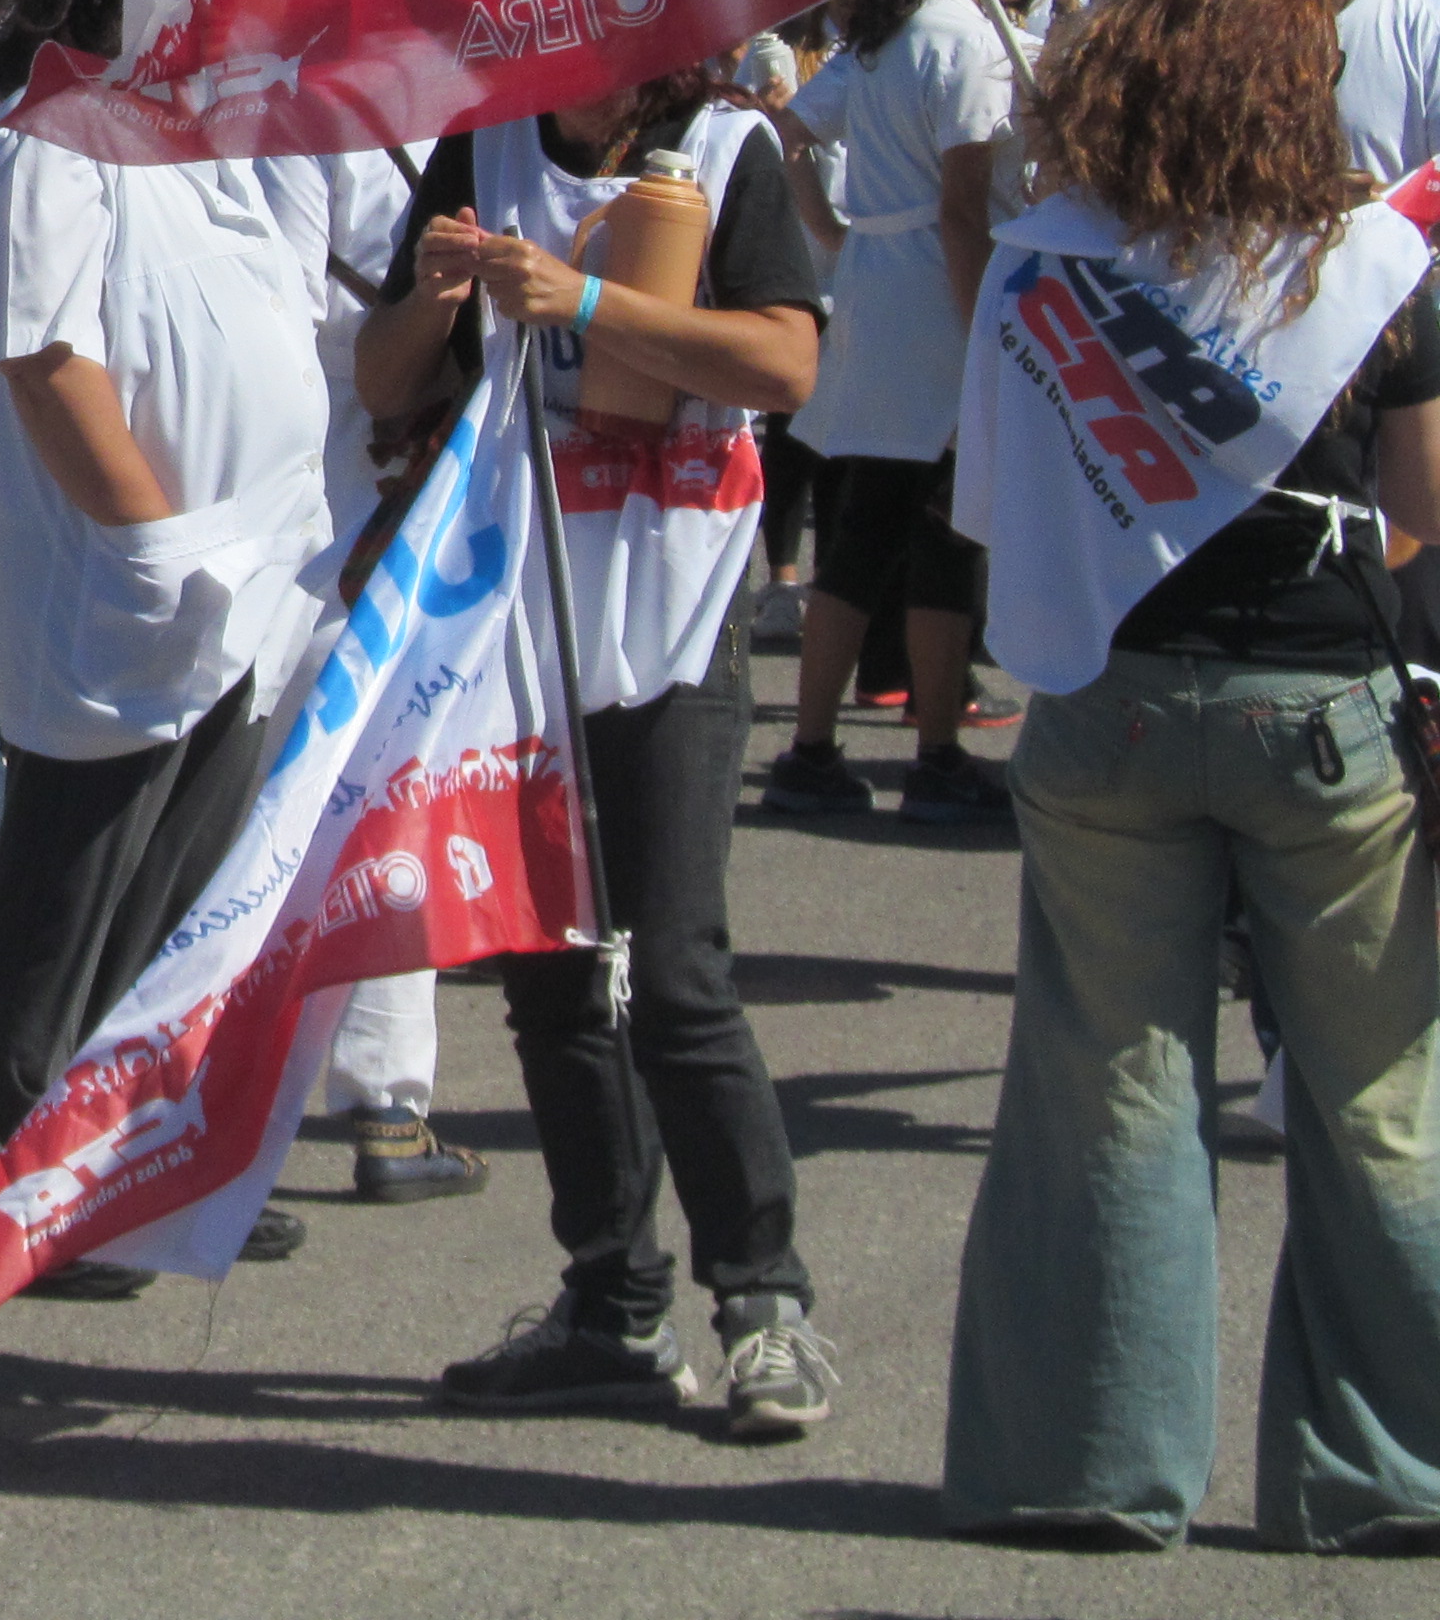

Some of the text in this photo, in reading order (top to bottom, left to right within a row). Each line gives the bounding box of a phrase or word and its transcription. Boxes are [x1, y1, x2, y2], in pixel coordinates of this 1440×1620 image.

[1014, 344, 1049, 386] los
[1017, 276, 1199, 506] CTA
[1194, 326, 1283, 404] Aires
